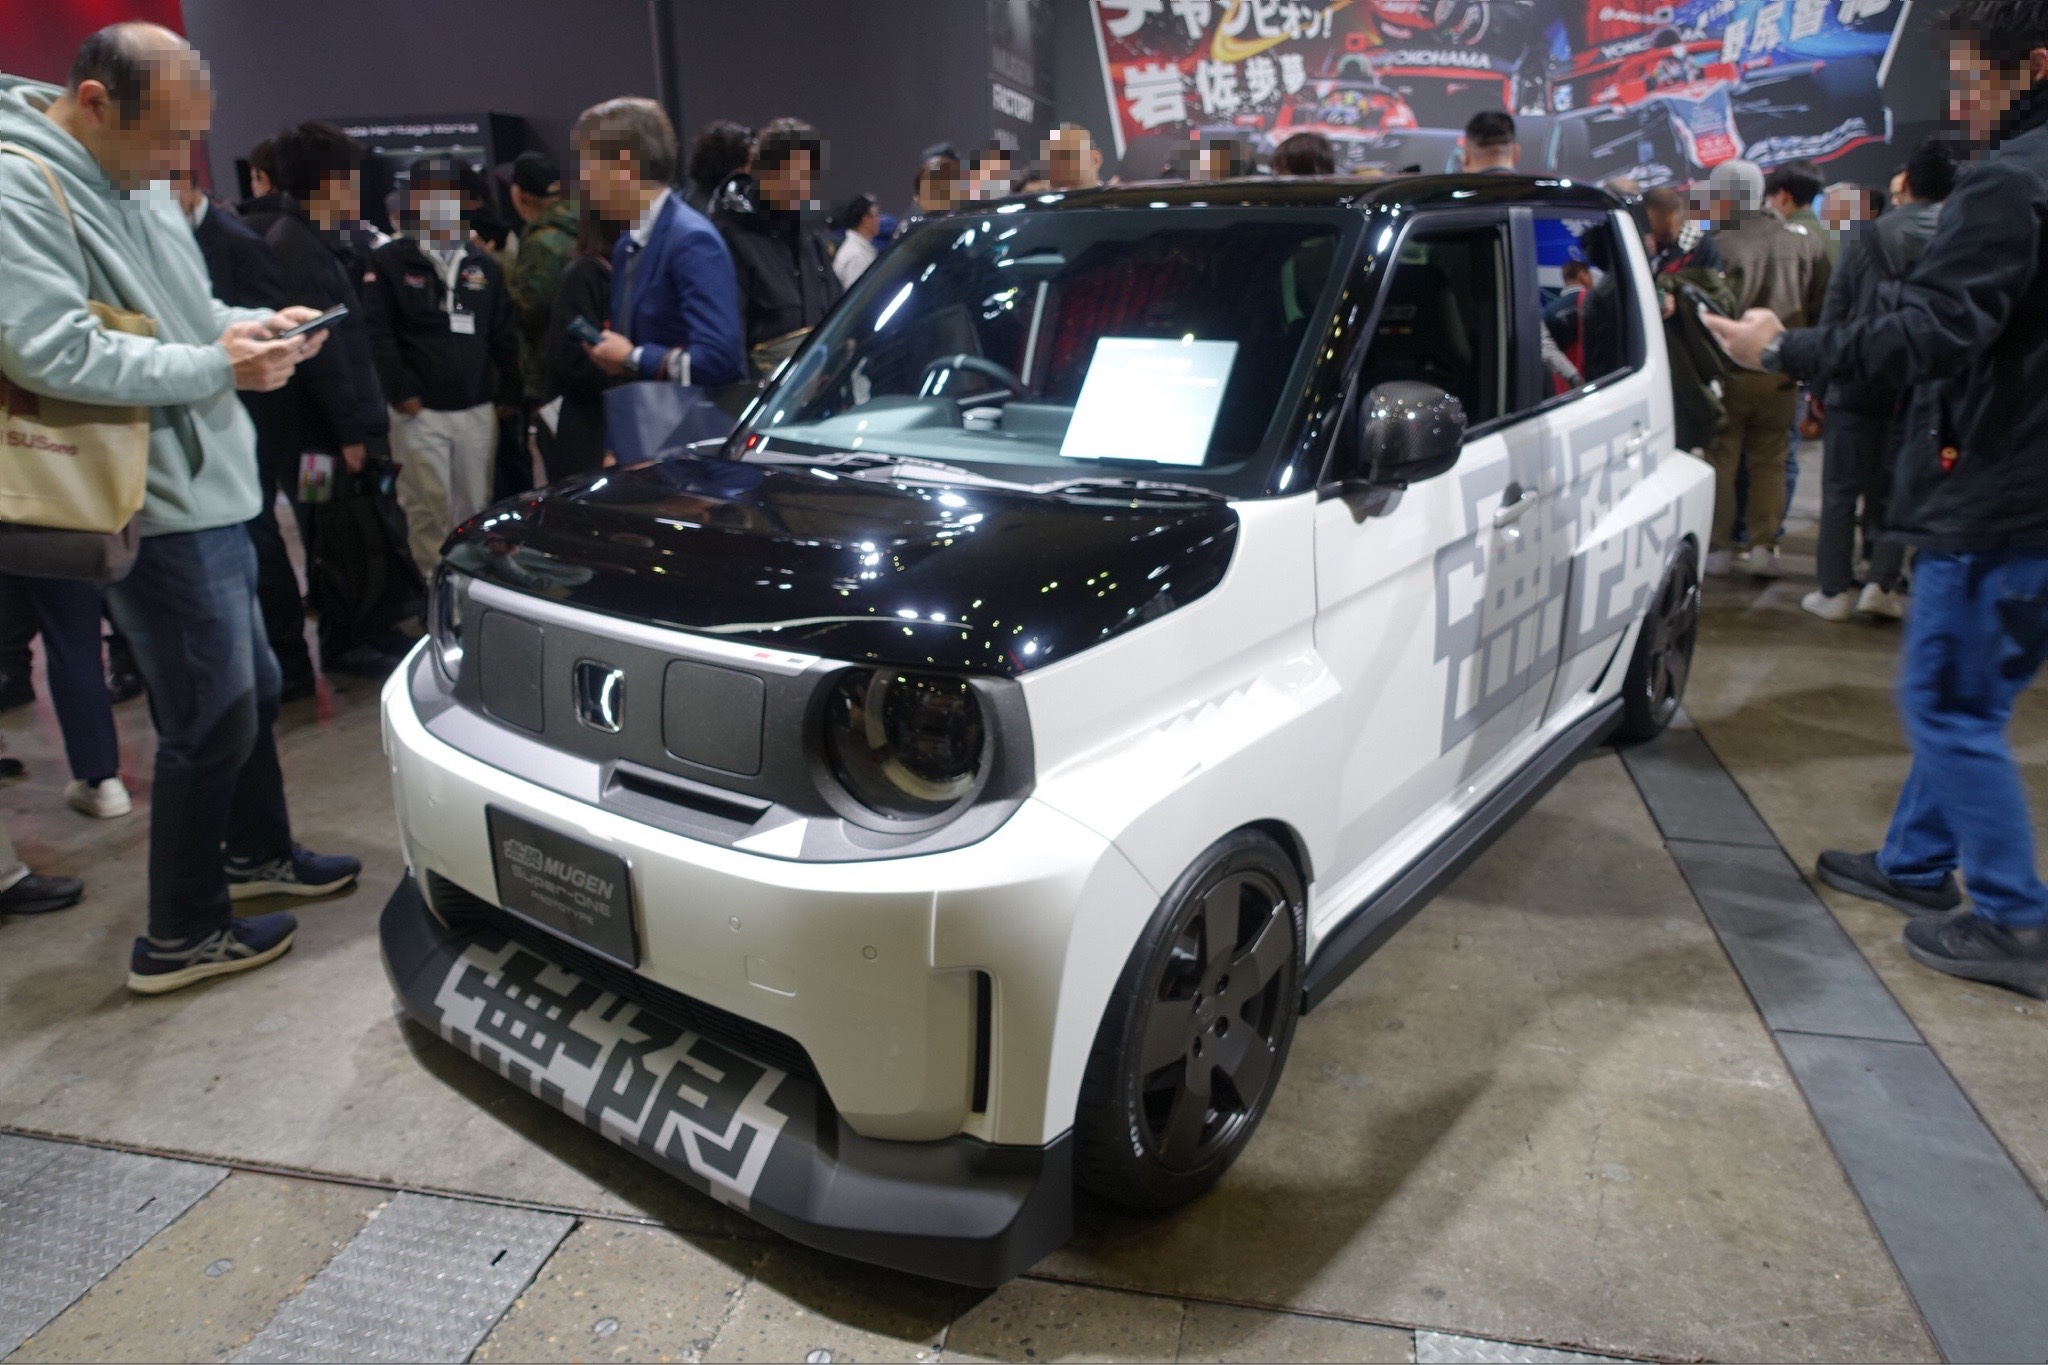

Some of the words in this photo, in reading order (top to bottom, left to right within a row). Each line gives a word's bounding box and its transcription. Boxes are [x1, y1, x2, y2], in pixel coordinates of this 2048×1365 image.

[1122, 53, 1307, 129] 岩佐歩夢
[543, 856, 614, 900] MUGEN
